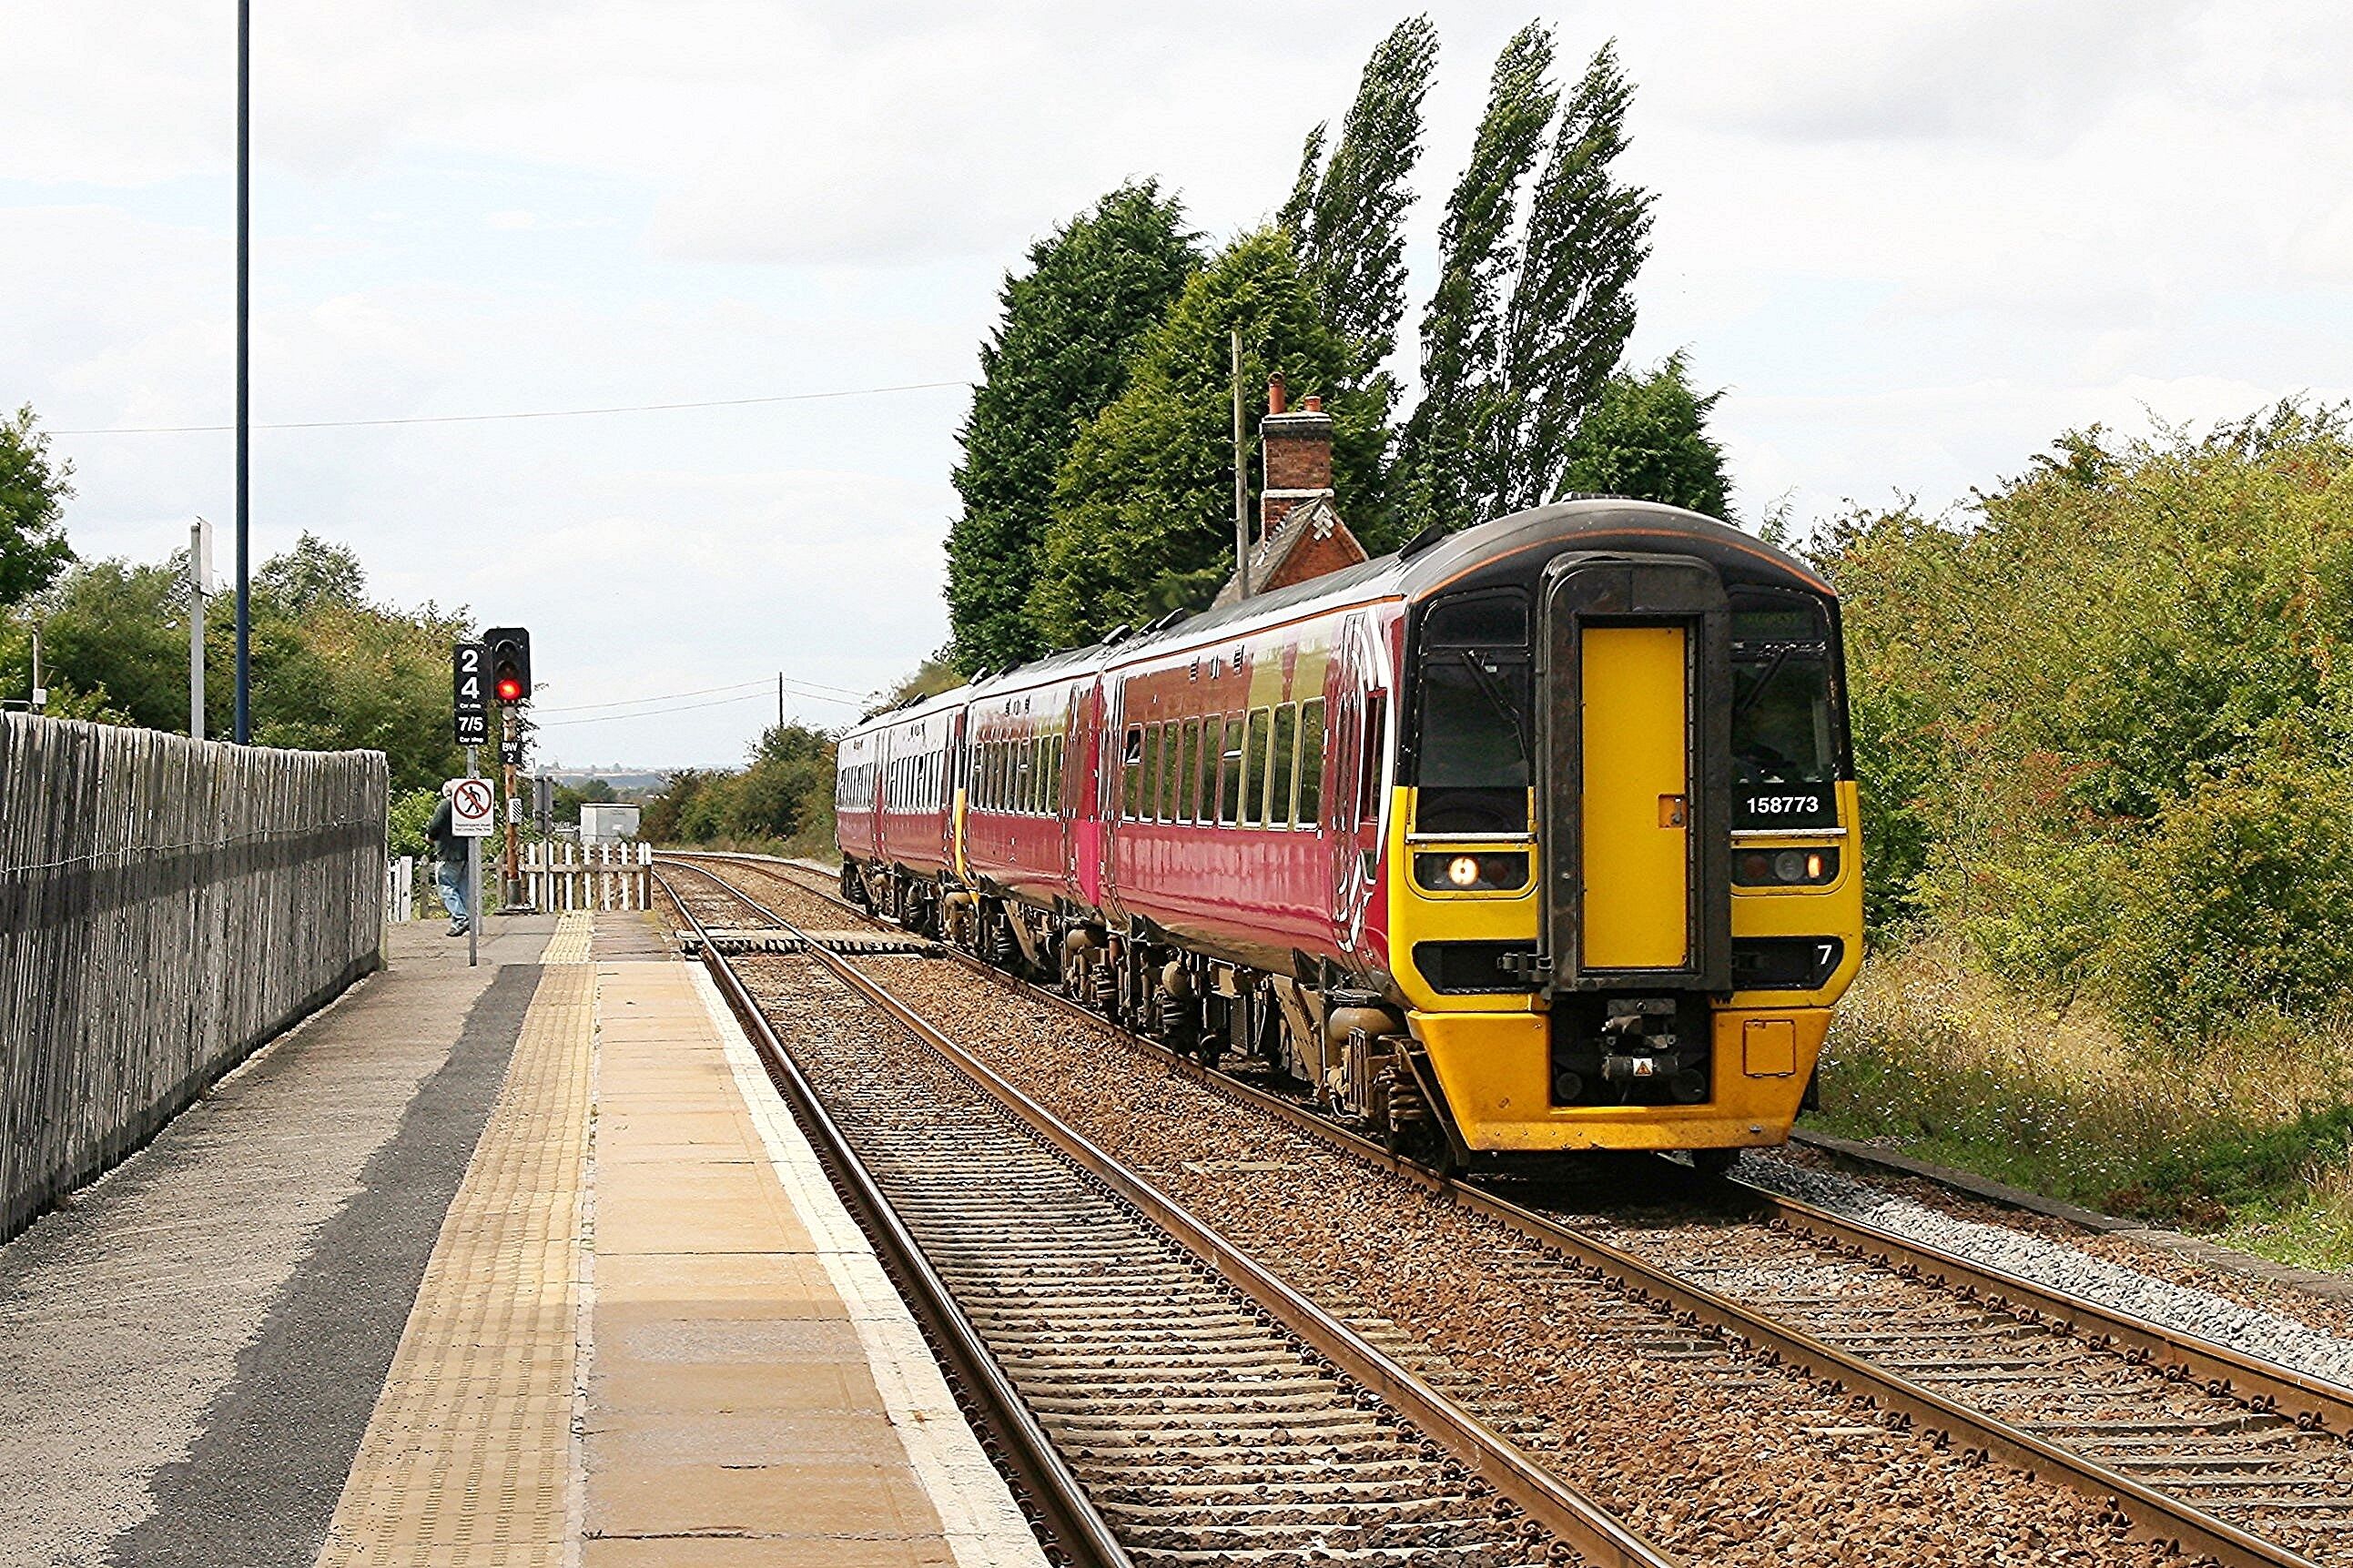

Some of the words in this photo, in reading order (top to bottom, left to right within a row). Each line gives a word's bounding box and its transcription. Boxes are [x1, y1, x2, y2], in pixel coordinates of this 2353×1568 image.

[461, 649, 479, 673] 2
[461, 676, 480, 699] 4
[458, 716, 483, 732] 7/5
[502, 742, 518, 752] BW
[507, 753, 514, 763] 2
[1747, 796, 1819, 814] 158773
[1817, 945, 1832, 965] 7
